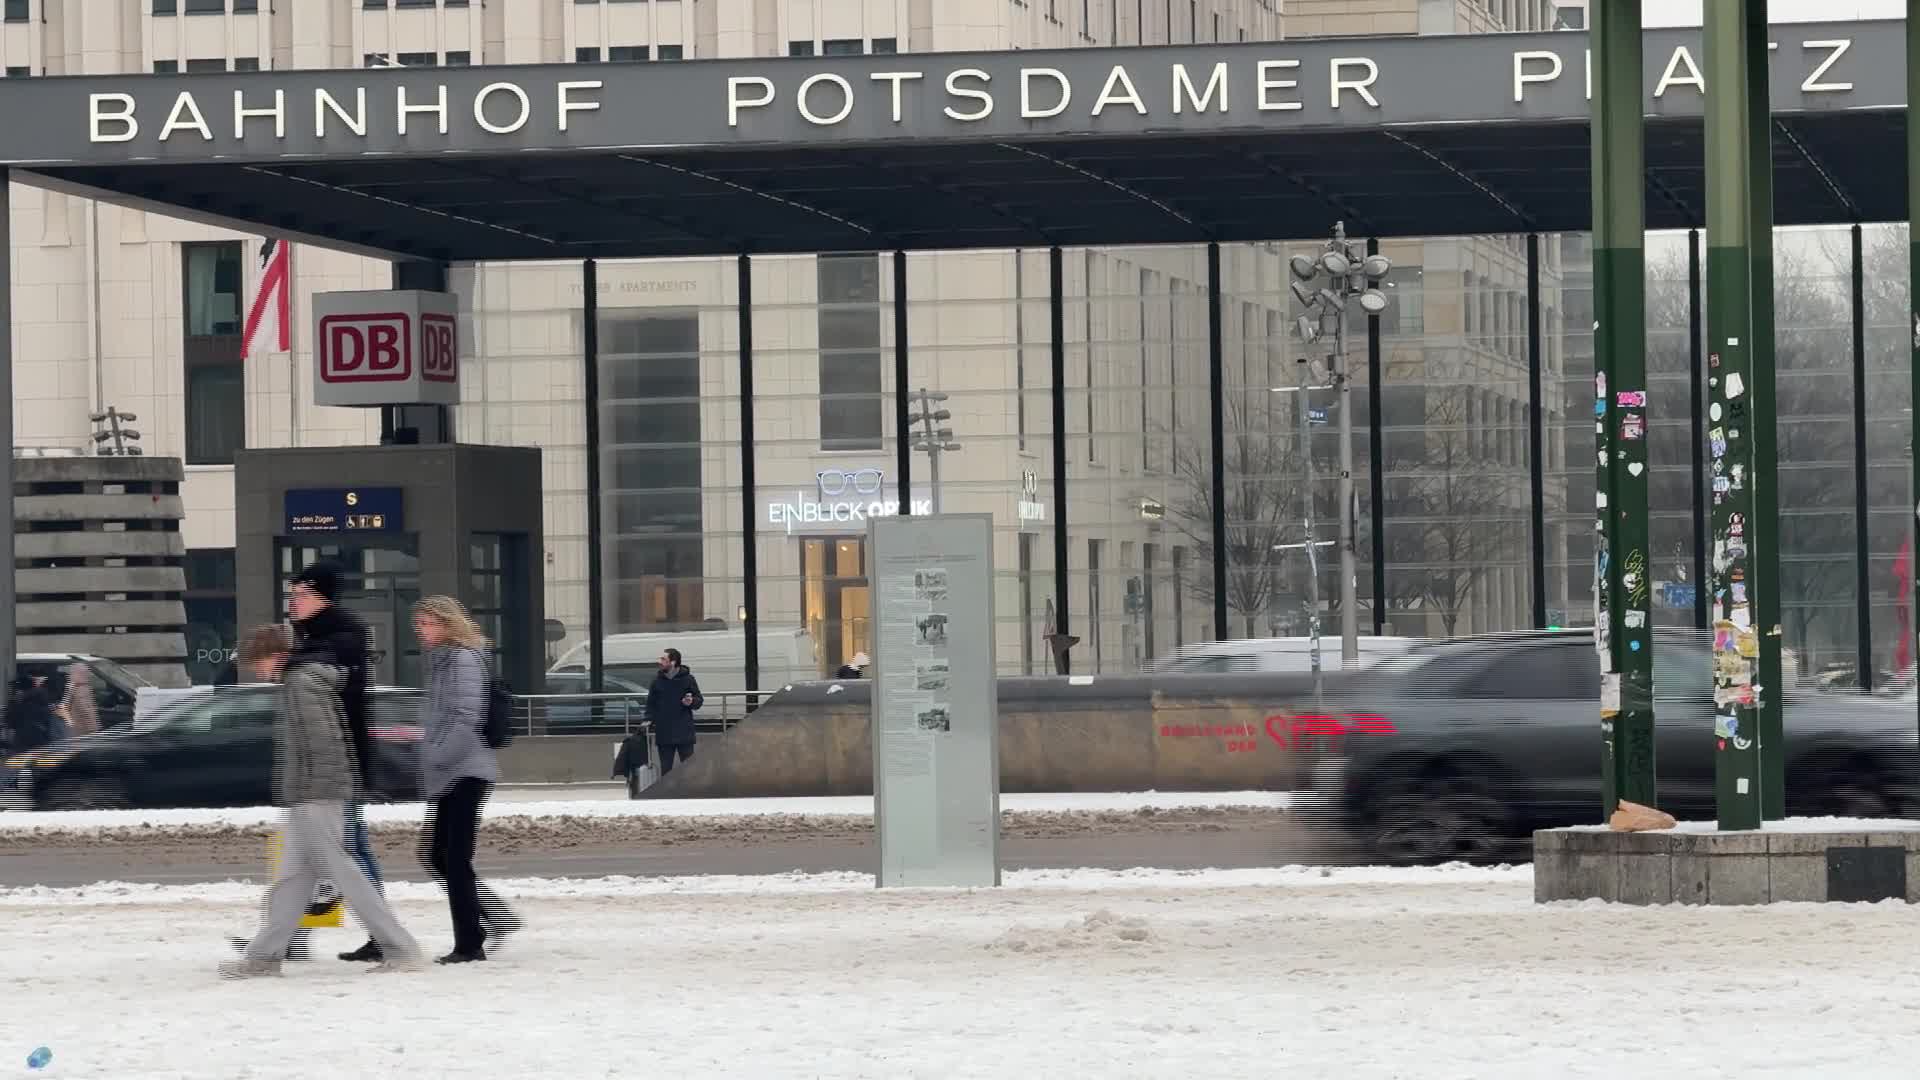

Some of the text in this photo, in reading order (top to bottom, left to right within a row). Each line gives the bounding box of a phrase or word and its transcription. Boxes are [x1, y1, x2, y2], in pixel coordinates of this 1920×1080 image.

[88, 39, 1853, 142] BAHNHOF POTSDAMER PAZ
[332, 325, 400, 371] DB
[425, 324, 453, 371] DB
[346, 492, 358, 506] S
[768, 490, 931, 535] EINBLICK OPIK
